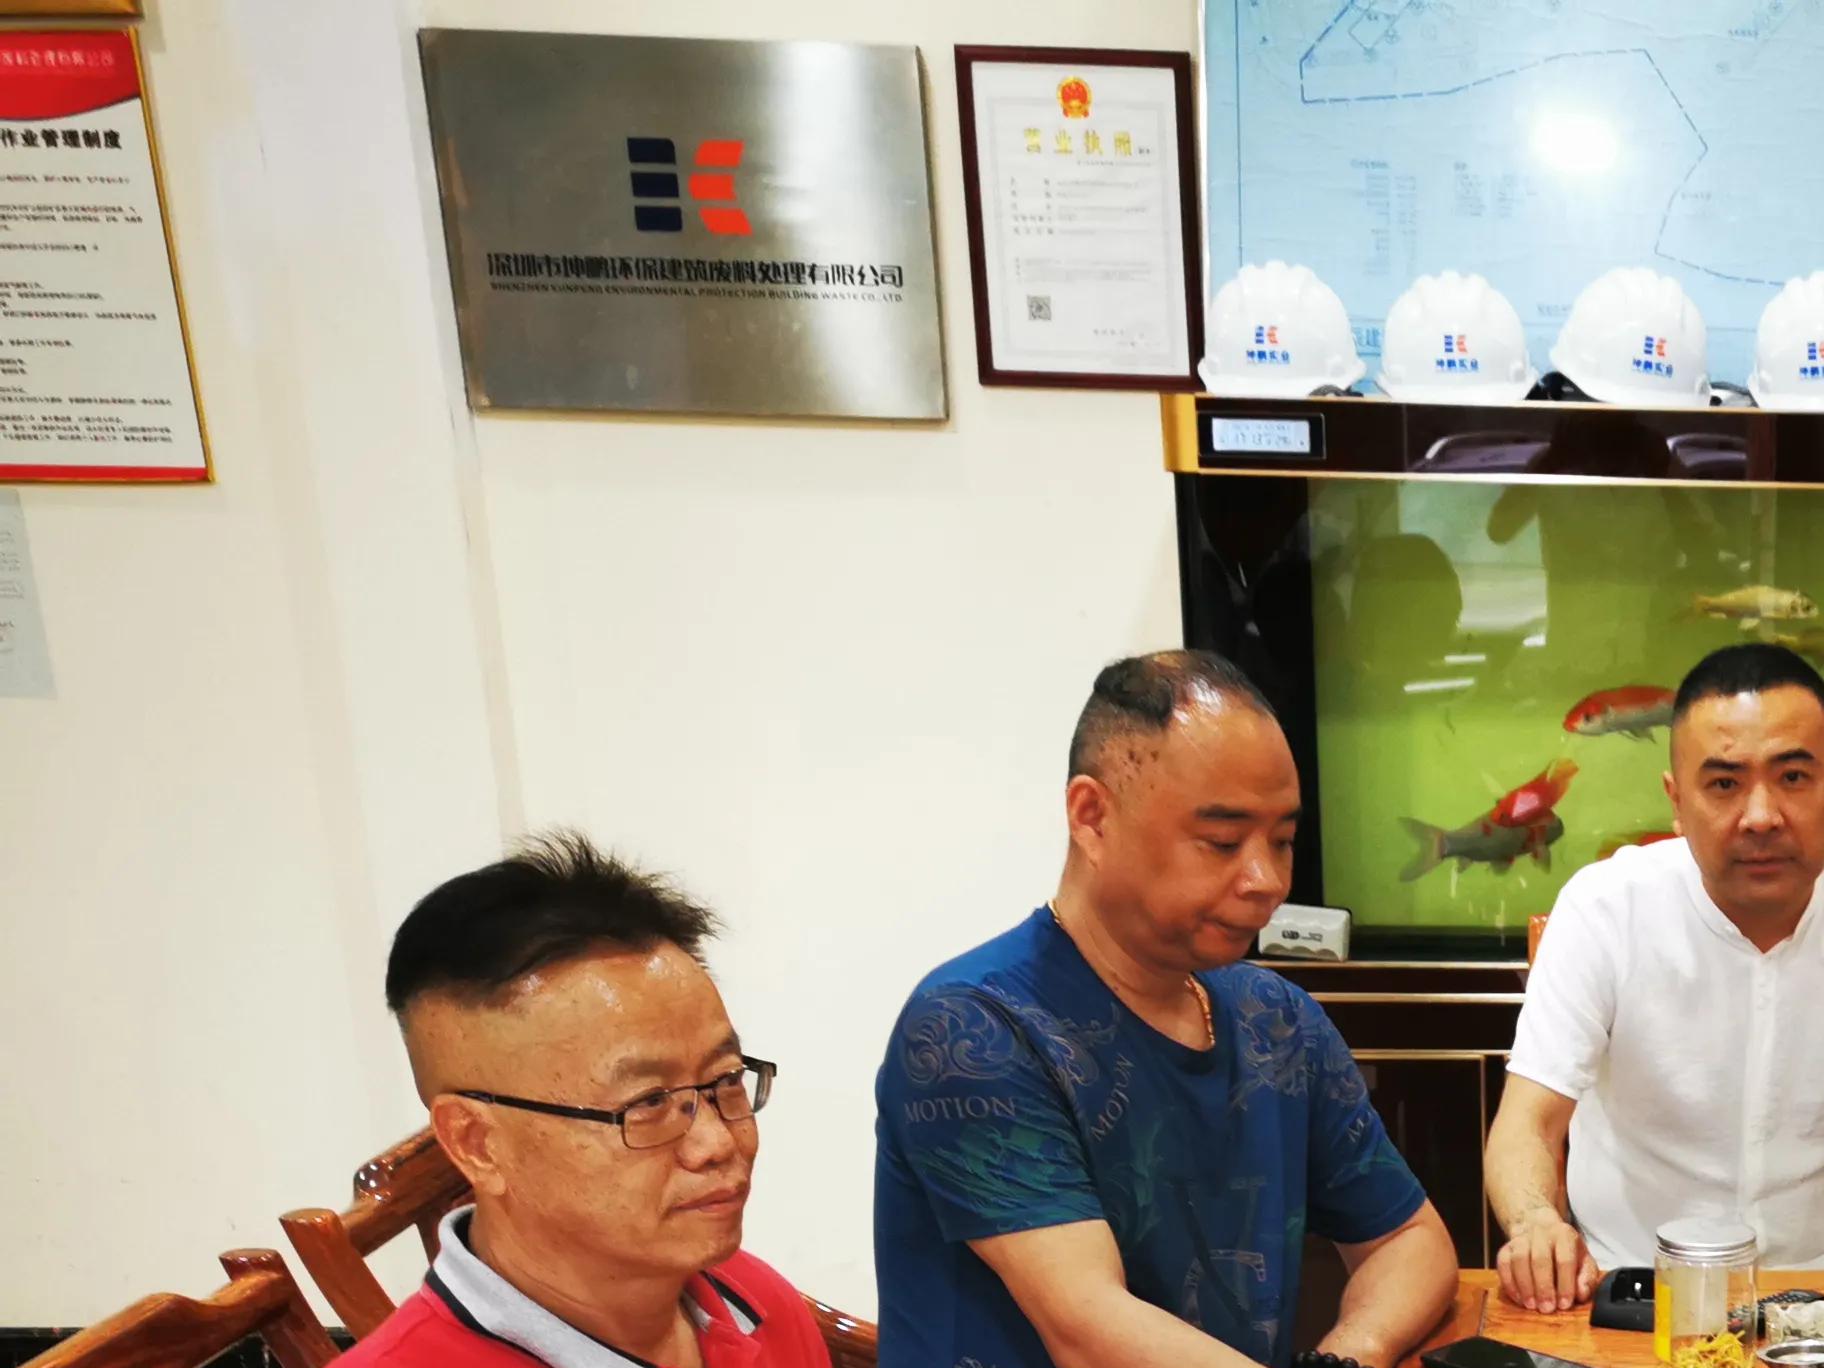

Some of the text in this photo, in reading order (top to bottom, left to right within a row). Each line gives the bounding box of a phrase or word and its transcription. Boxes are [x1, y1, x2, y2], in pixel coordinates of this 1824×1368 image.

[1023, 127, 1132, 156] 营业执照
[699, 287, 766, 299] PROTECTION
[768, 289, 818, 300] BUILDING
[904, 1095, 1018, 1124] MOTION
